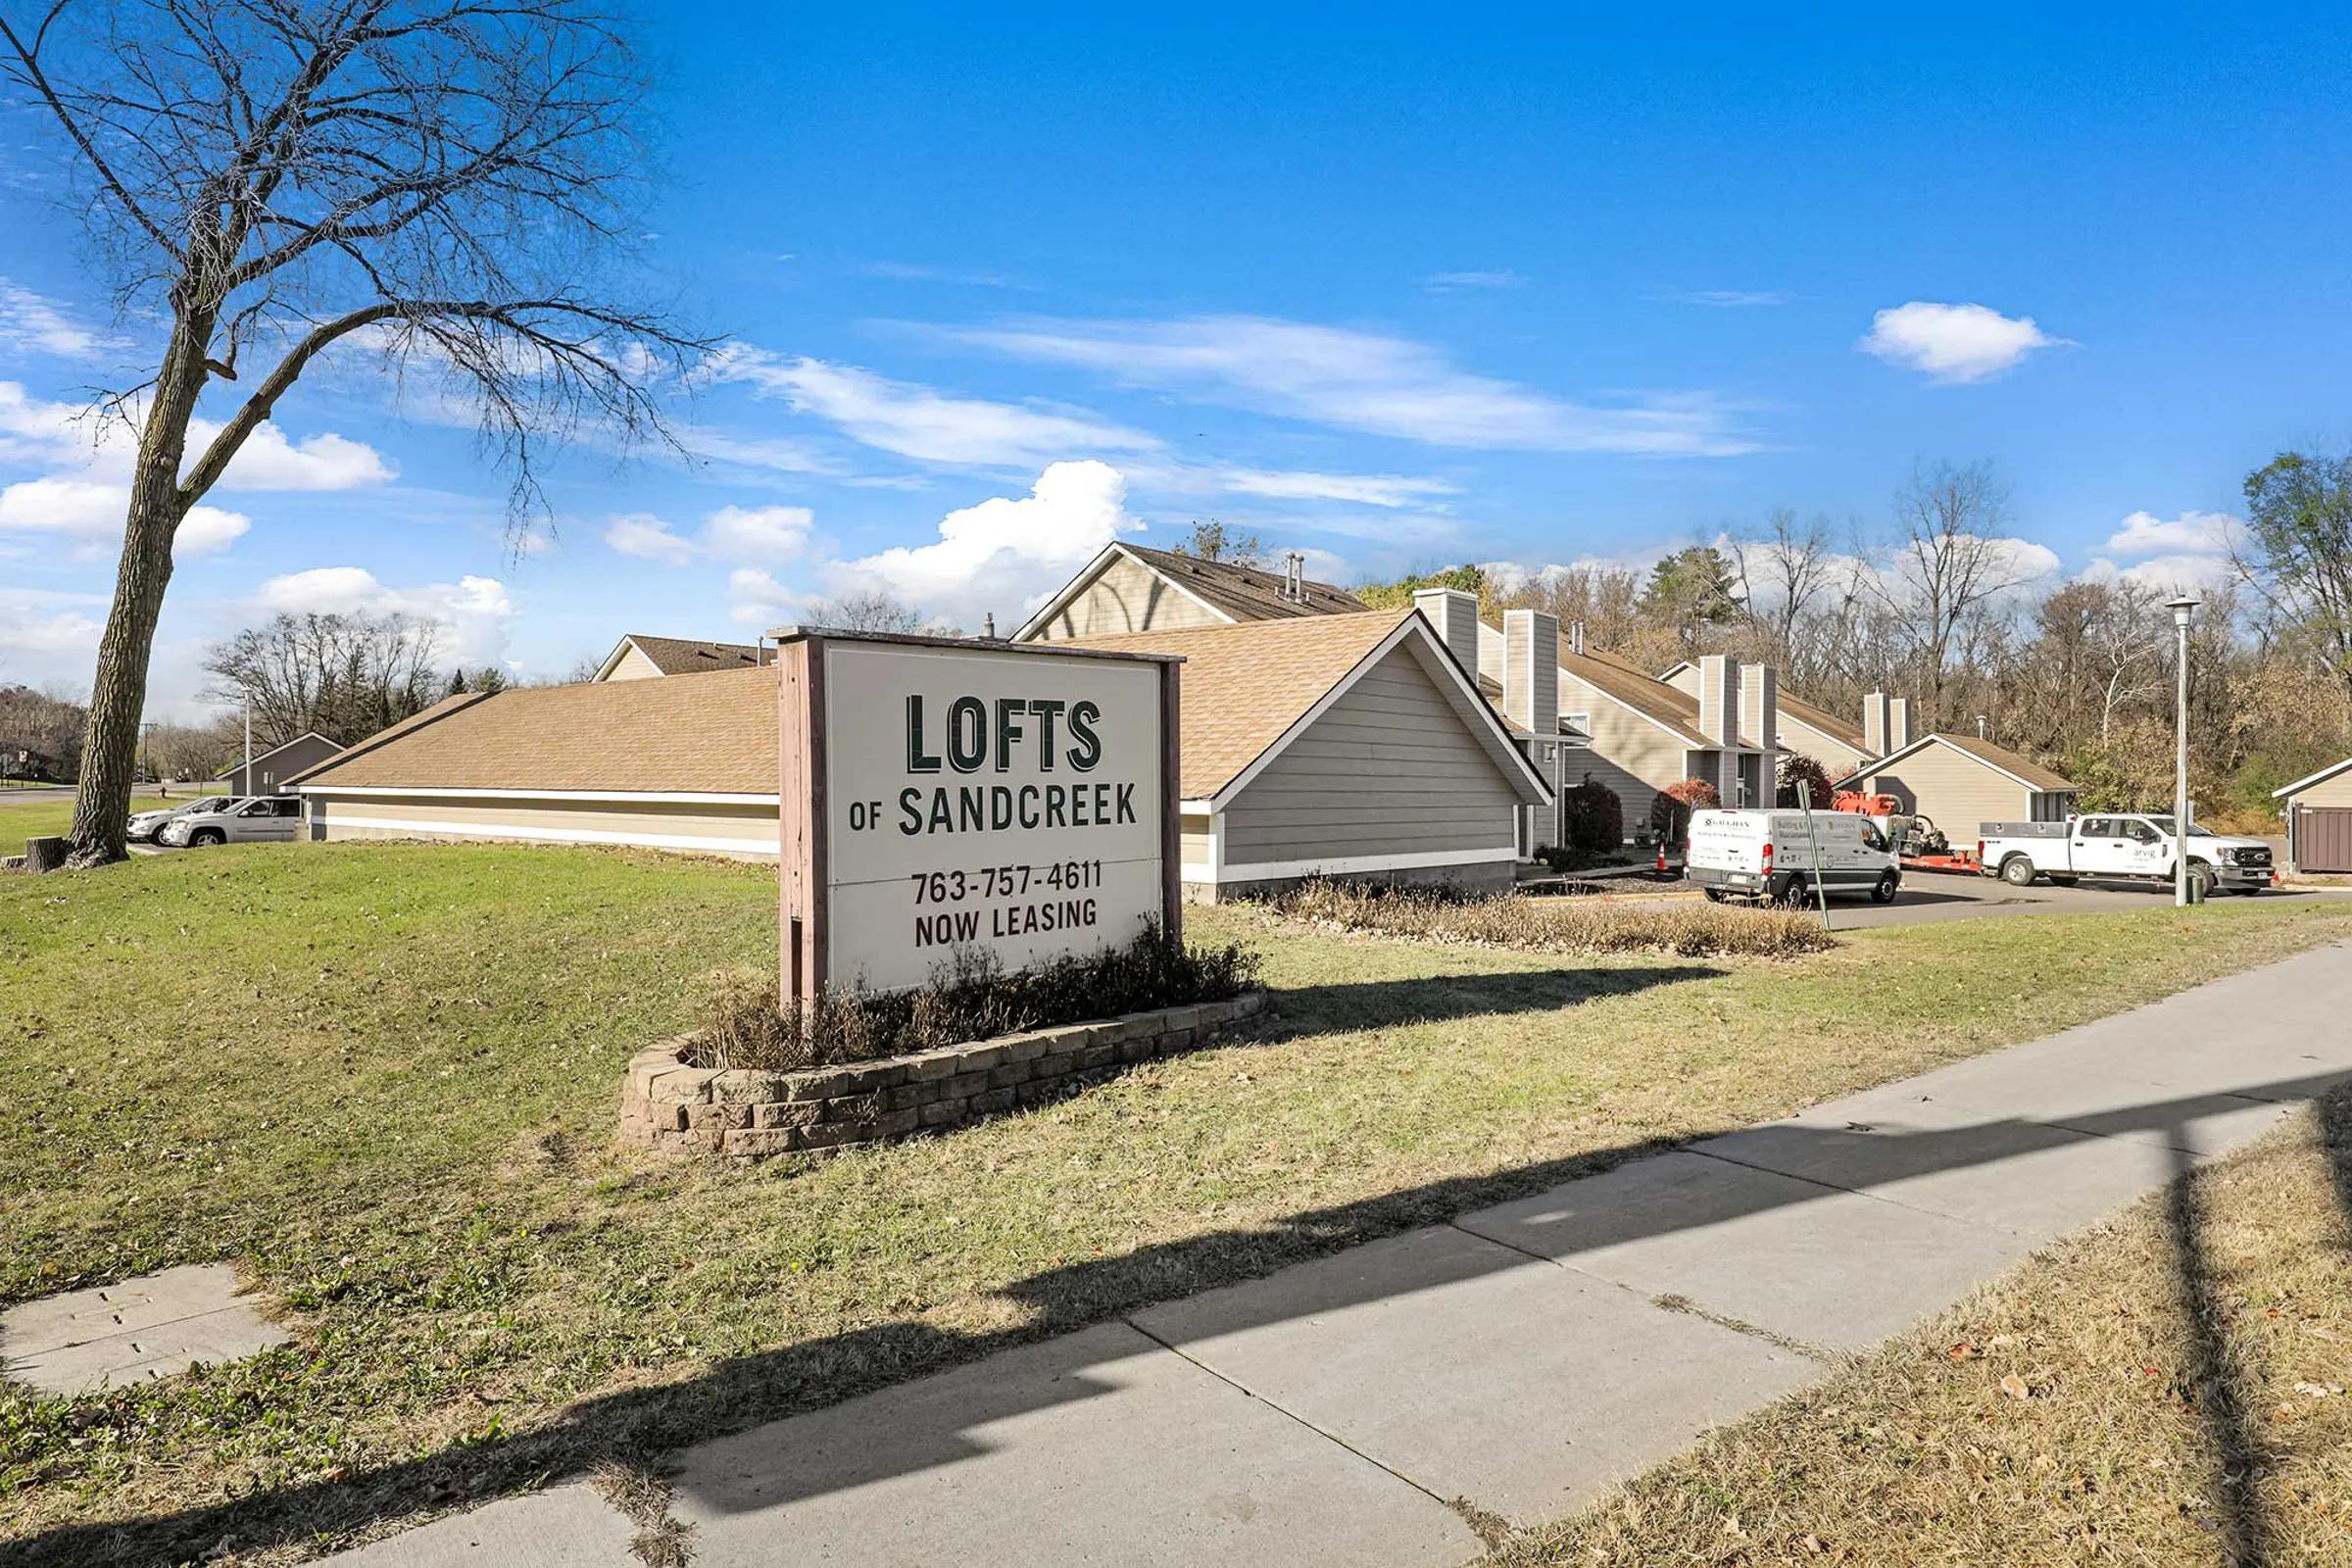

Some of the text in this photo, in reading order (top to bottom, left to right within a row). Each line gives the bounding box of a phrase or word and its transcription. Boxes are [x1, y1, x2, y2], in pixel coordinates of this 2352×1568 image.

[906, 694, 1102, 775] LOFTS
[849, 782, 1137, 836] OF SANDCREEK
[910, 858, 1102, 905] 763-757-4611
[915, 898, 1097, 948] NOW LEASING
